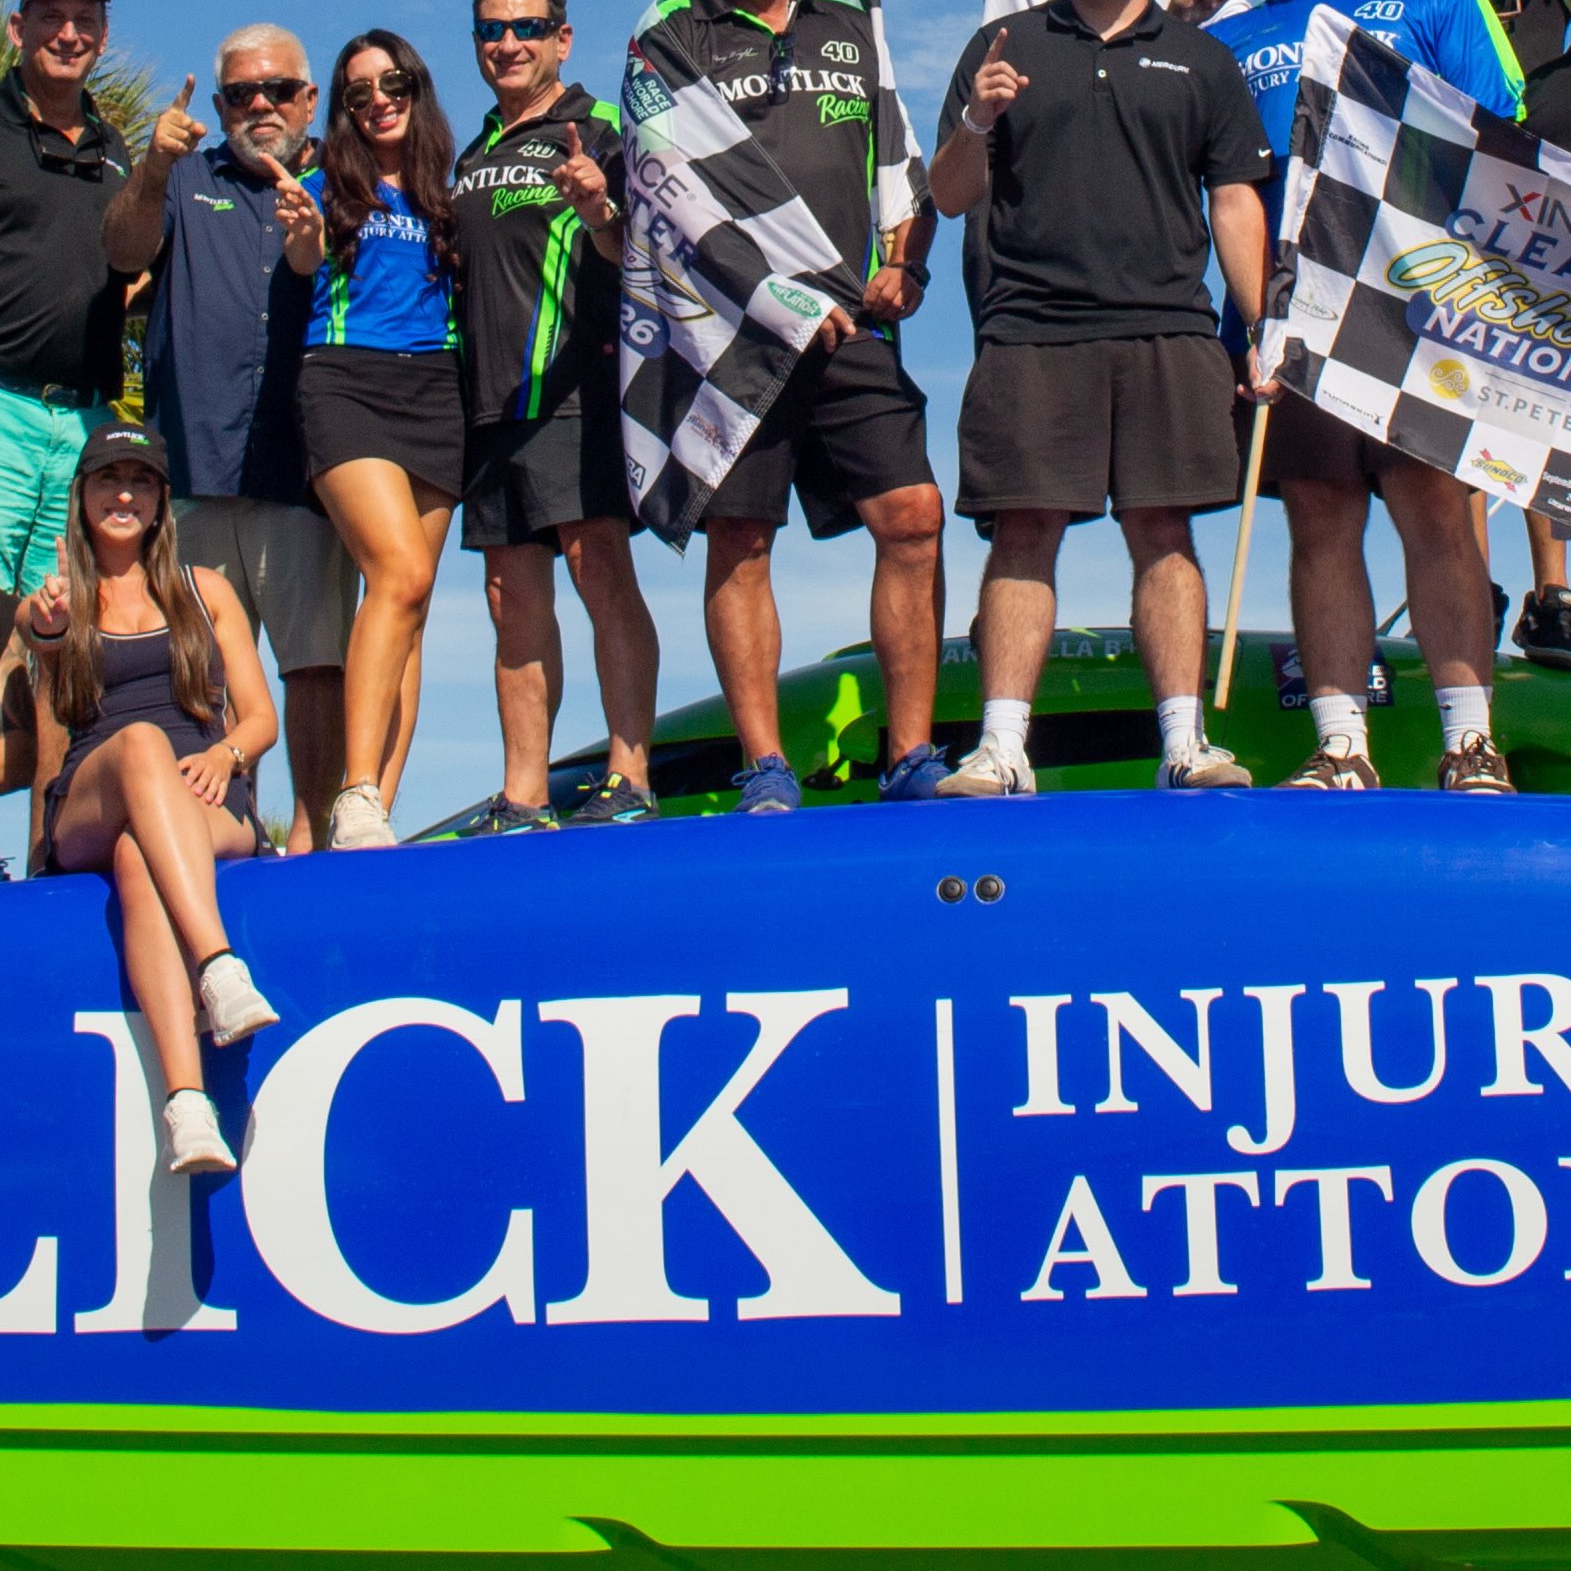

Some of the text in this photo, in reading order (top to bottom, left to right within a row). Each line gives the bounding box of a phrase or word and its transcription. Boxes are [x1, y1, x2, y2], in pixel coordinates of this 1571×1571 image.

[1354, 0, 1405, 21] 40
[820, 40, 860, 65] 40
[632, 77, 660, 116] WORLD
[645, 79, 672, 110] RACE
[517, 138, 558, 160] 40
[491, 183, 562, 217] Racing
[1475, 460, 1527, 484] SUNOCO
